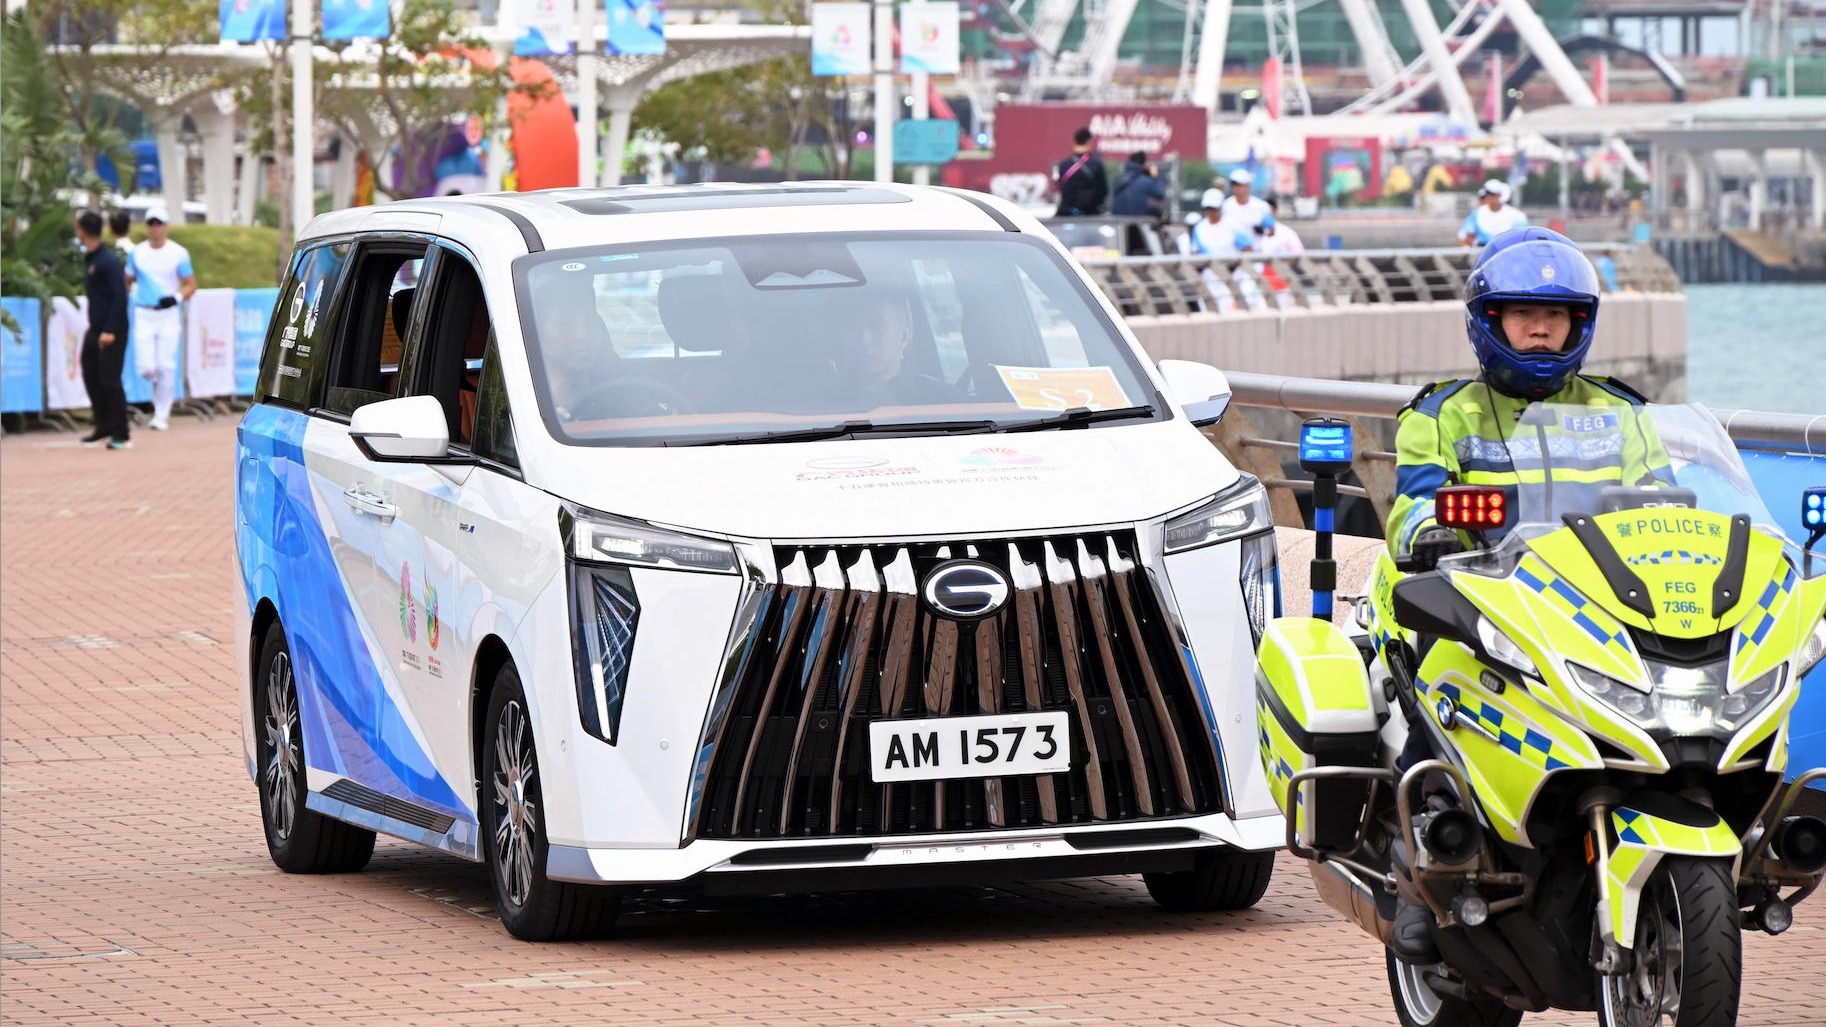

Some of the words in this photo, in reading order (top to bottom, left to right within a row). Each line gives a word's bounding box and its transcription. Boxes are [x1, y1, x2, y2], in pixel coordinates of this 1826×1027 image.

[1572, 416, 1606, 431] FEG
[1616, 522, 1633, 538] 警
[1636, 518, 1706, 536] POLICE
[1707, 523, 1723, 538] 察
[1664, 581, 1697, 593] FEG
[1663, 601, 1697, 613] 7366
[1680, 619, 1693, 629] W
[884, 731, 940, 769] AM
[960, 725, 1058, 765] 1573
